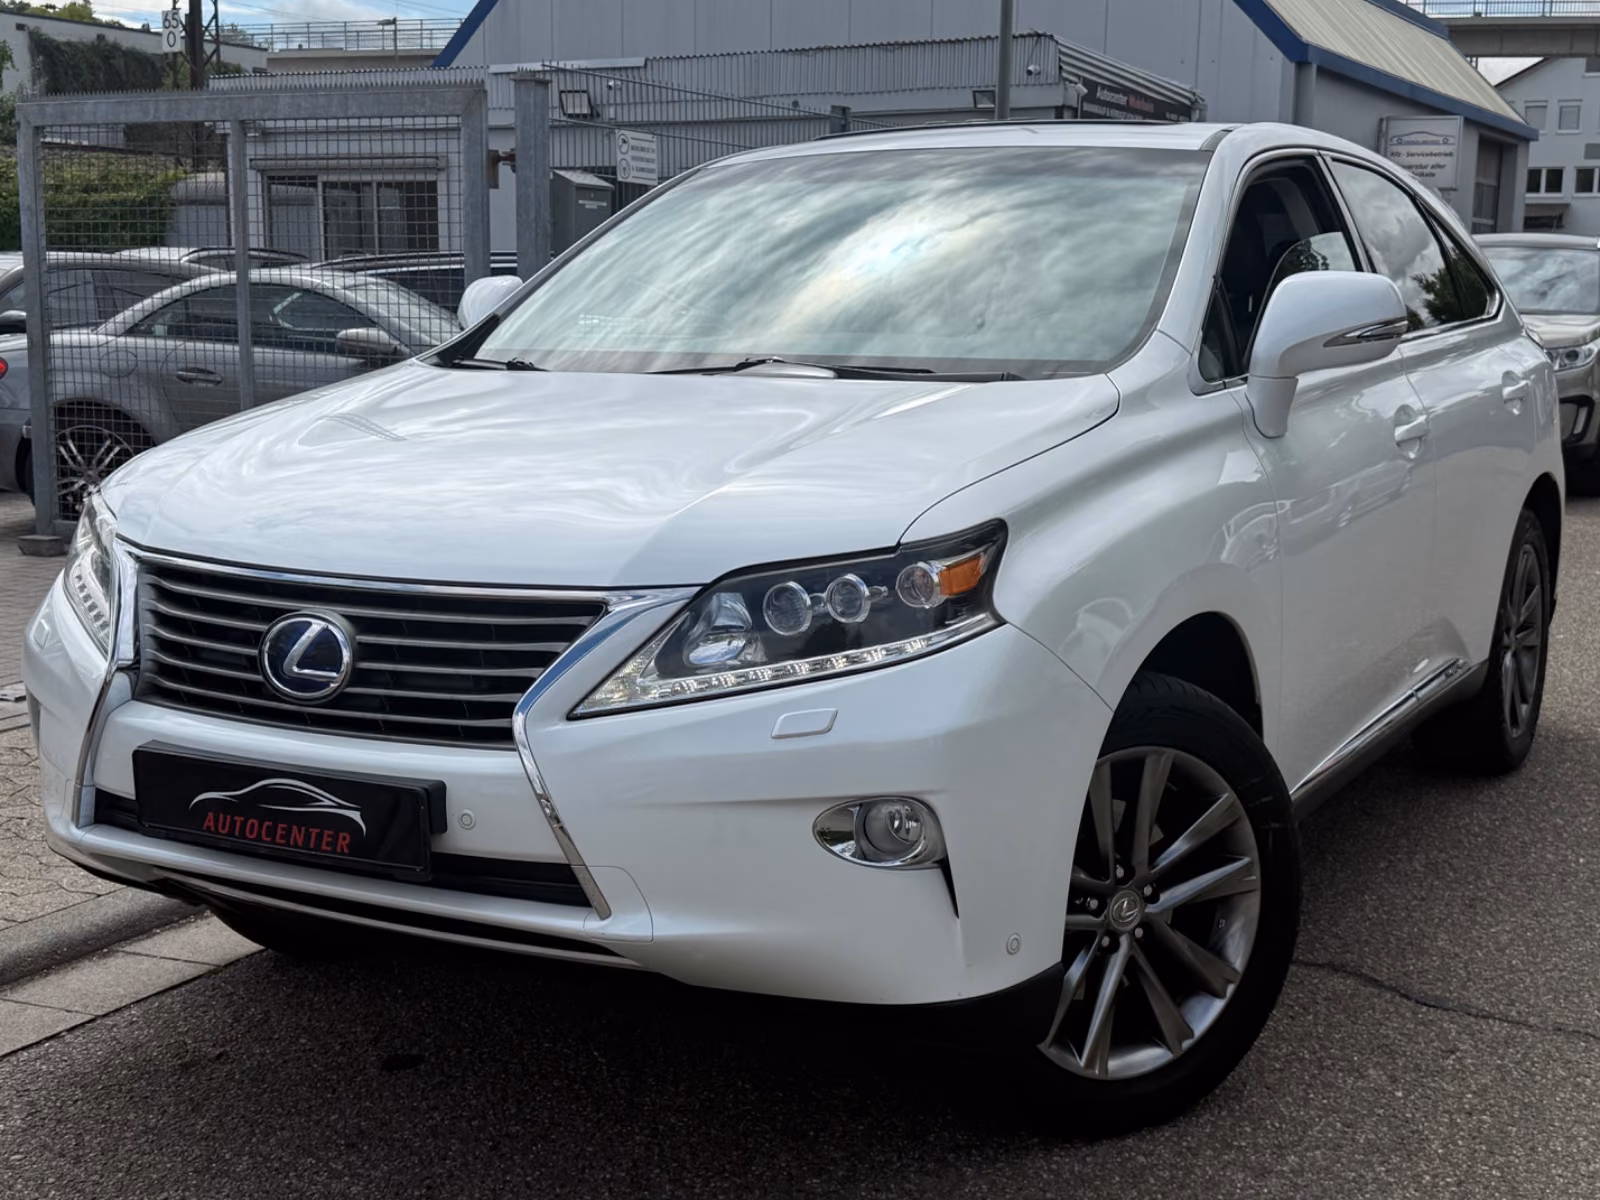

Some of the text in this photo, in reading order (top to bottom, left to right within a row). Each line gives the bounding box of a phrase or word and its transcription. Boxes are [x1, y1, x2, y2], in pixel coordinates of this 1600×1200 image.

[163, 12, 179, 29] 65
[166, 30, 177, 48] 0
[203, 811, 350, 853] AUTOCENTER
